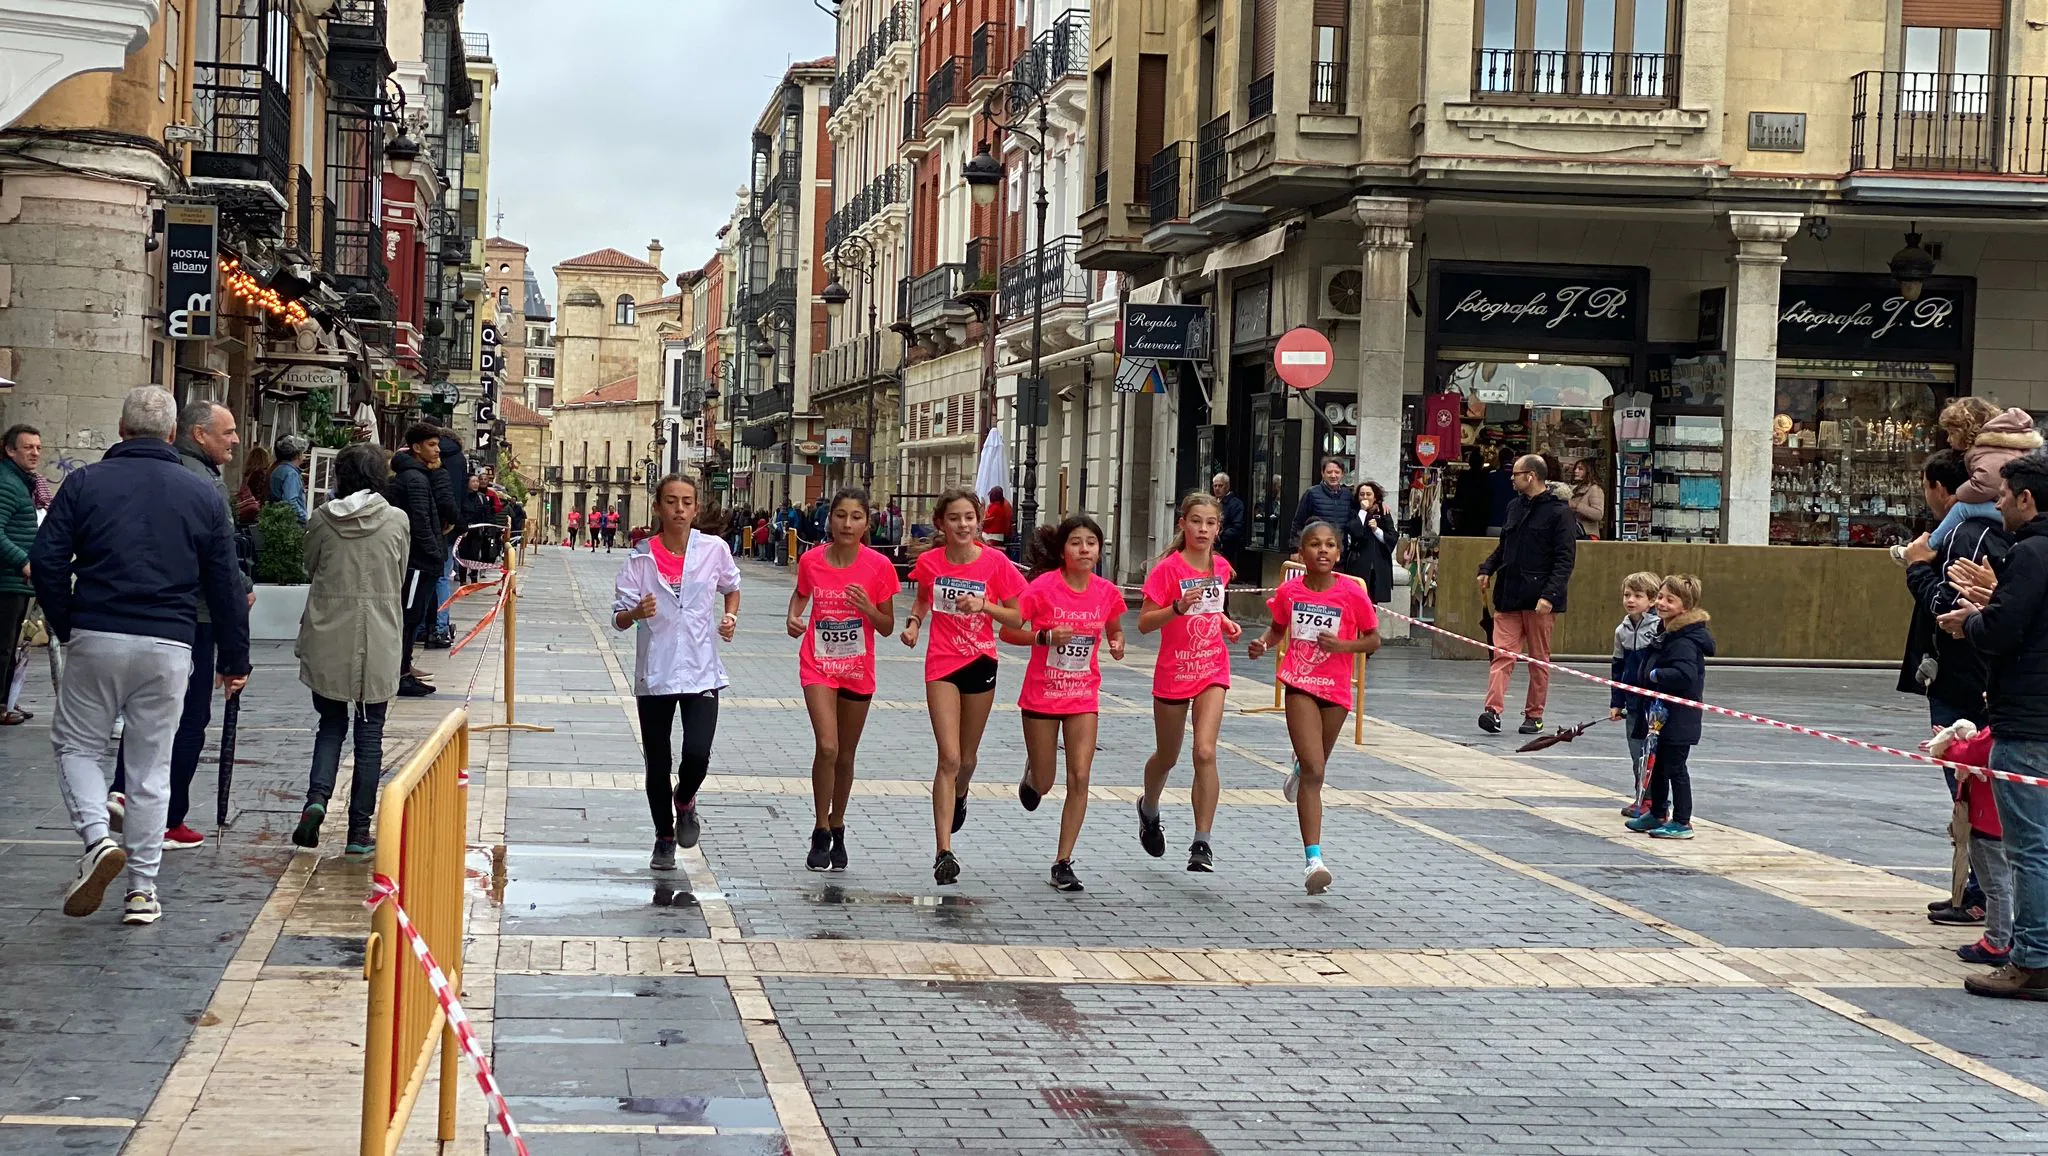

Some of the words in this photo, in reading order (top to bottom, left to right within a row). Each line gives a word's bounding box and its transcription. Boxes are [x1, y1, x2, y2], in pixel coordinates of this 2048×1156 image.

[1761, 126, 1792, 134] PLAZA
[170, 249, 209, 259] HOSTAL
[172, 262, 208, 273] albany
[1445, 289, 1548, 323] fotografia
[1129, 312, 1178, 333] Regalos
[1778, 300, 1874, 334] fotografia
[1129, 335, 1182, 350] Souvenir
[1297, 613, 1333, 629] 3764
[822, 630, 858, 643] 0356
[1056, 644, 1090, 657] 0355
[1291, 676, 1336, 686] CARRERA
